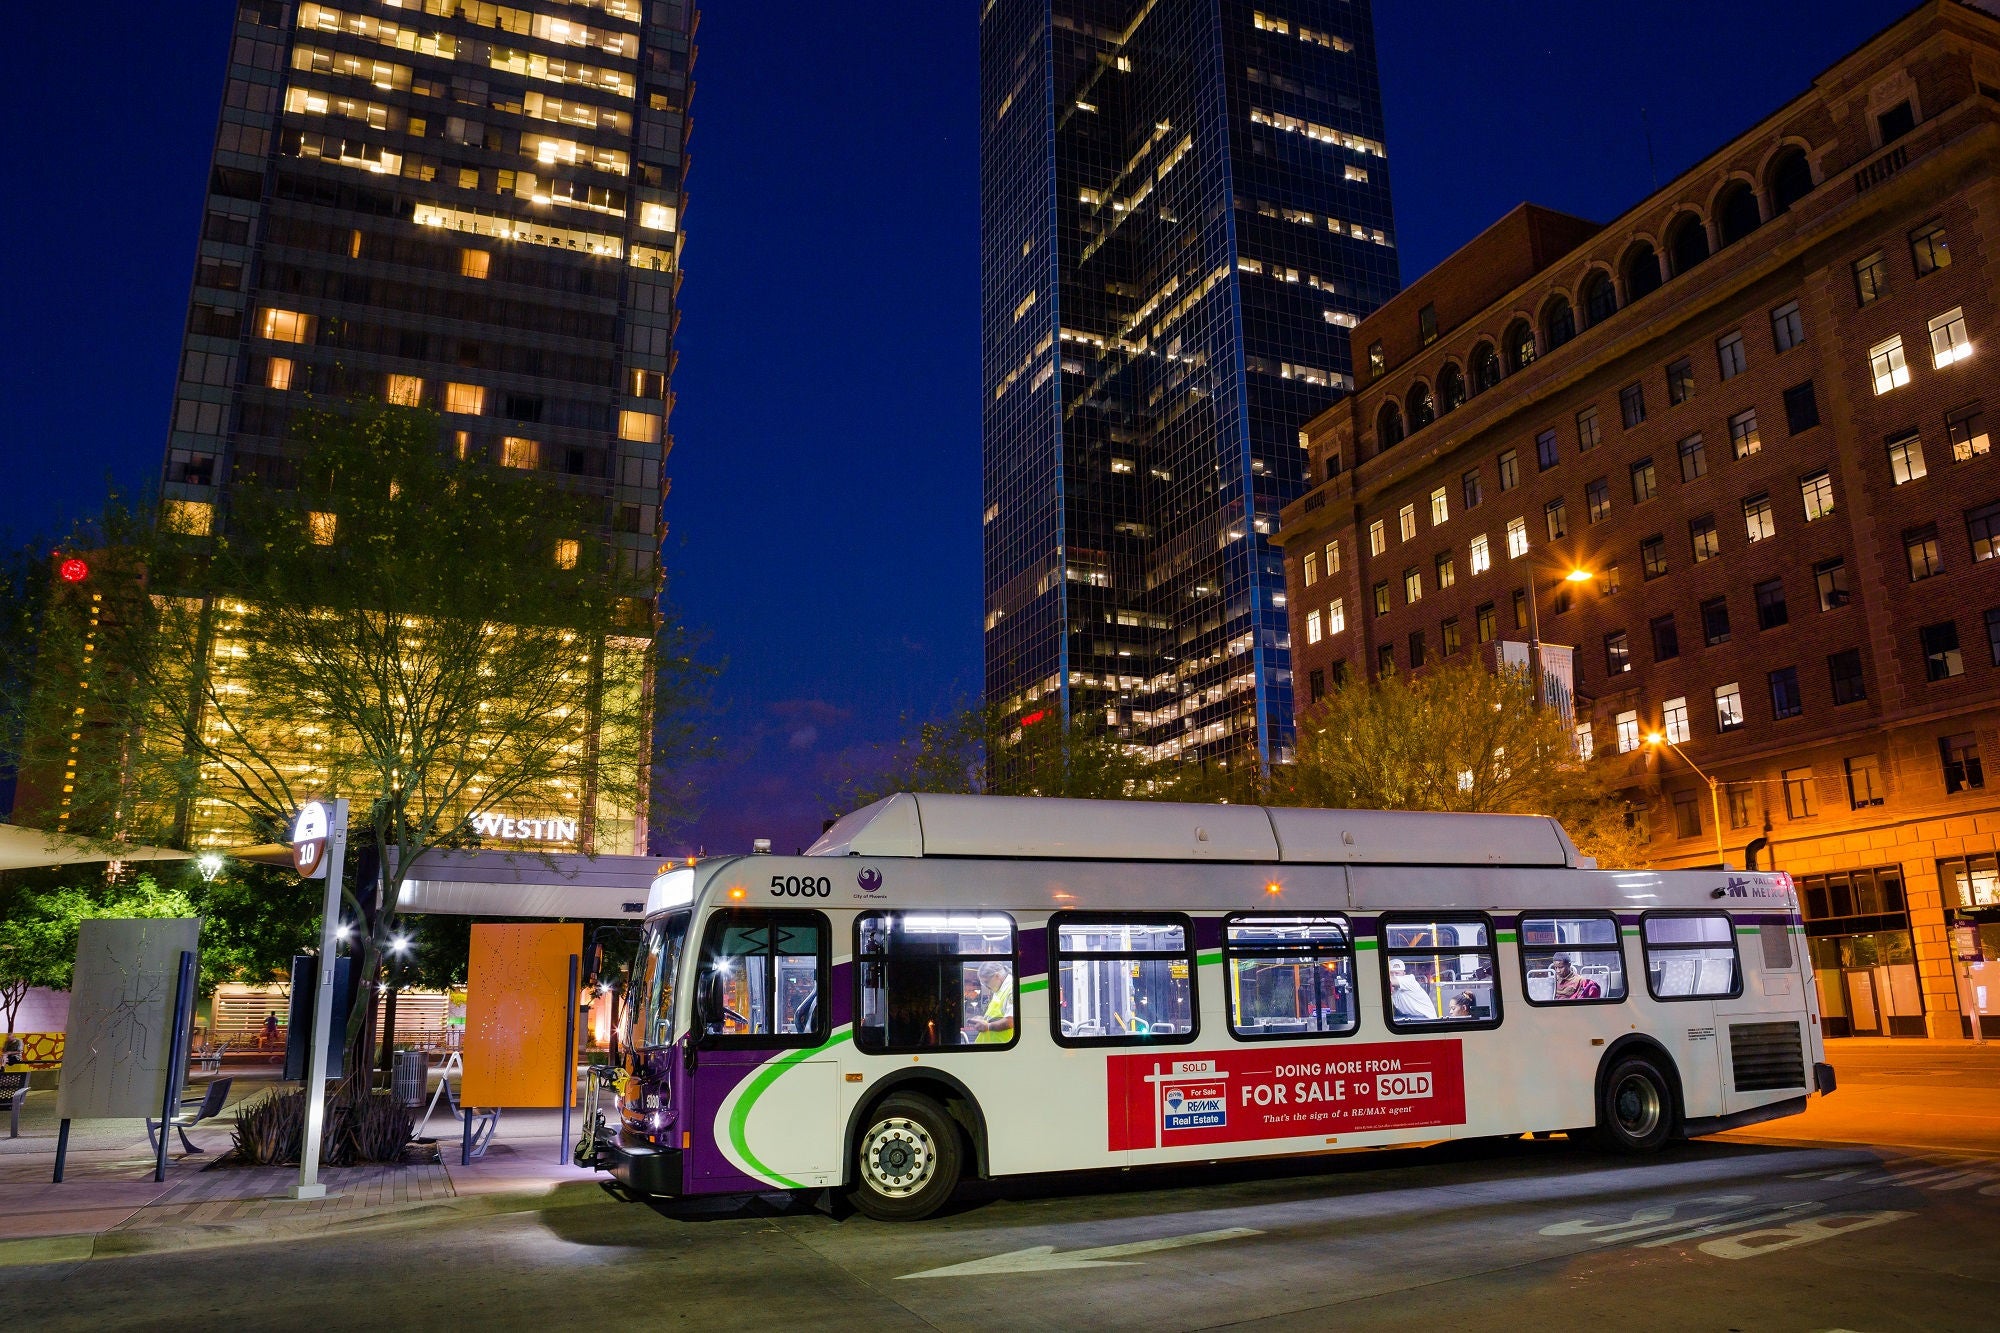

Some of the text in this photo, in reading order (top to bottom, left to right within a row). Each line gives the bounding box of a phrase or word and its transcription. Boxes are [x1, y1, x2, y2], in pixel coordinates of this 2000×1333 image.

[467, 811, 576, 841] WESTIN
[299, 842, 315, 866] 10
[770, 875, 831, 898] 5080
[1182, 1062, 1208, 1073] SOLD
[1275, 1058, 1402, 1078] DOING MORE FROM
[1190, 1088, 1217, 1097] For Sale
[1241, 1076, 1430, 1107] FOR SALE TO SOLD
[1187, 1099, 1220, 1113] RE/MAX
[1263, 1113, 1290, 1123] That's
[1293, 1112, 1307, 1121] the
[1309, 1111, 1329, 1121] sign
[1331, 1109, 1341, 1118] of
[1351, 1106, 1386, 1117] RE/MAX
[1388, 1105, 1413, 1115] agent
[1172, 1114, 1219, 1126] Real Estate
